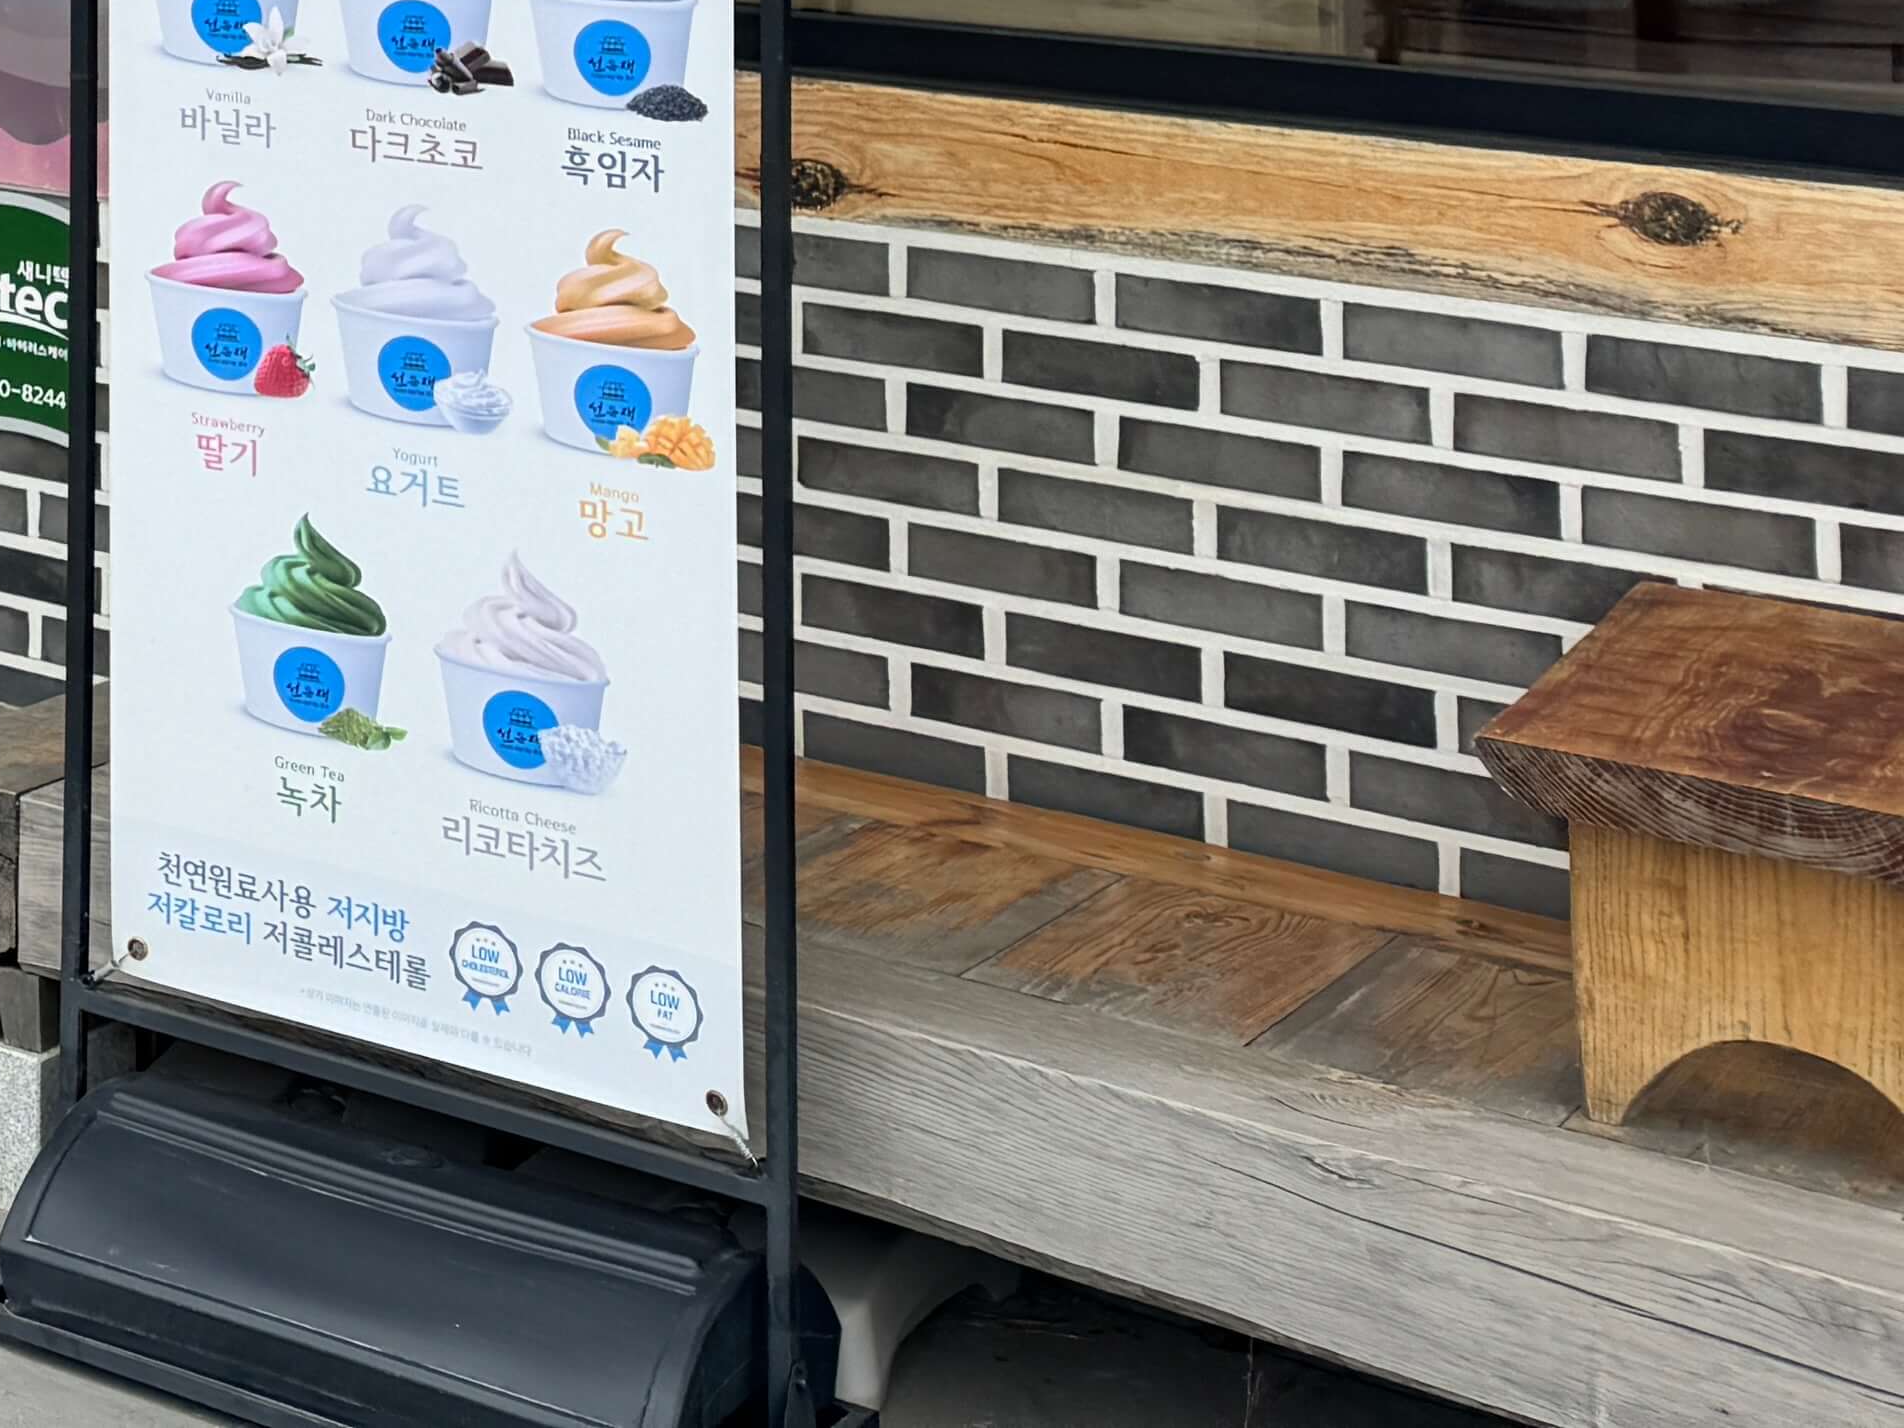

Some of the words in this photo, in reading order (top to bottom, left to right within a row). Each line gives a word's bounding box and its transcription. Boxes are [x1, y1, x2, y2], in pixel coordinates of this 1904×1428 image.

[206, 88, 251, 105] Vanilla
[179, 105, 276, 149] 바닐라
[366, 107, 397, 126] Dark
[401, 110, 467, 132] Chocolate
[349, 124, 484, 171] 다크초코
[566, 126, 605, 147] Black
[609, 130, 662, 151] Sesame
[561, 146, 665, 192] 흑임자
[191, 410, 266, 437] Strawberry
[196, 434, 258, 477] 딸기
[392, 446, 439, 468] Yogurt
[366, 464, 465, 509] 요거트
[589, 481, 640, 504] Mango
[578, 498, 649, 542] 망고
[274, 753, 315, 777] Green
[318, 759, 345, 784] Tea
[275, 776, 343, 825] 녹차
[469, 797, 520, 824] Ricotta
[525, 809, 577, 835] Cheese
[441, 814, 607, 882] 리코타치즈
[157, 851, 317, 920] 천연원료사용
[327, 896, 410, 943] 저지방
[147, 891, 252, 945] 저칼로리
[263, 921, 432, 992] 저콜레스테롤
[471, 944, 500, 964] LOW
[554, 982, 590, 1001] CALORIE
[558, 966, 587, 987] LOW
[649, 990, 680, 1010] LOW
[656, 1009, 673, 1021] FAT
